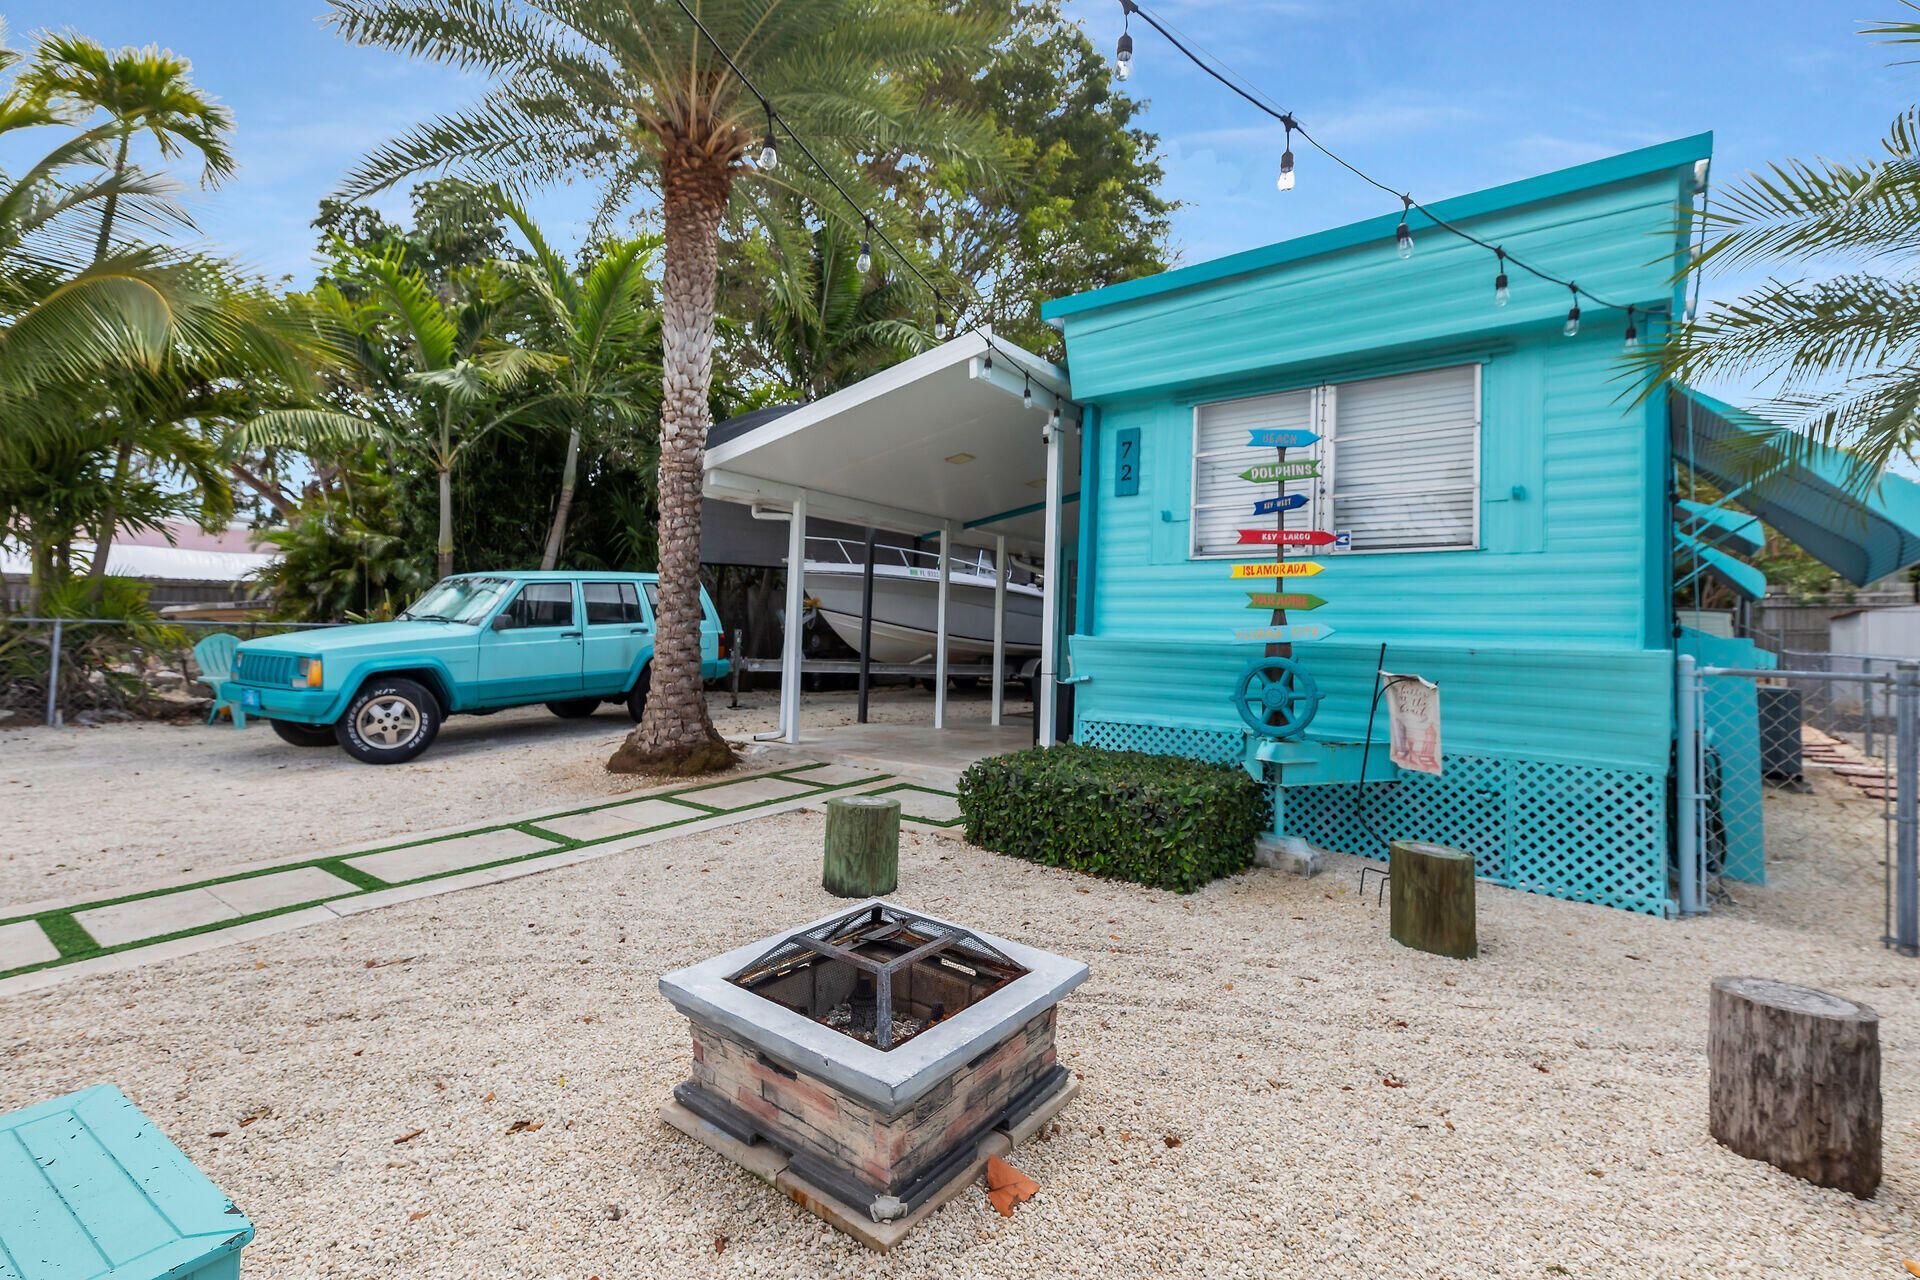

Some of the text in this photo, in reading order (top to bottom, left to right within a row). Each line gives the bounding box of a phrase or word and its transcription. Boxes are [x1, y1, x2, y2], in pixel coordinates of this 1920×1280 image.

[1121, 441, 1132, 481] 72
[1251, 464, 1312, 479] DOLPHINS
[1242, 563, 1307, 576] ISLAMORADA
